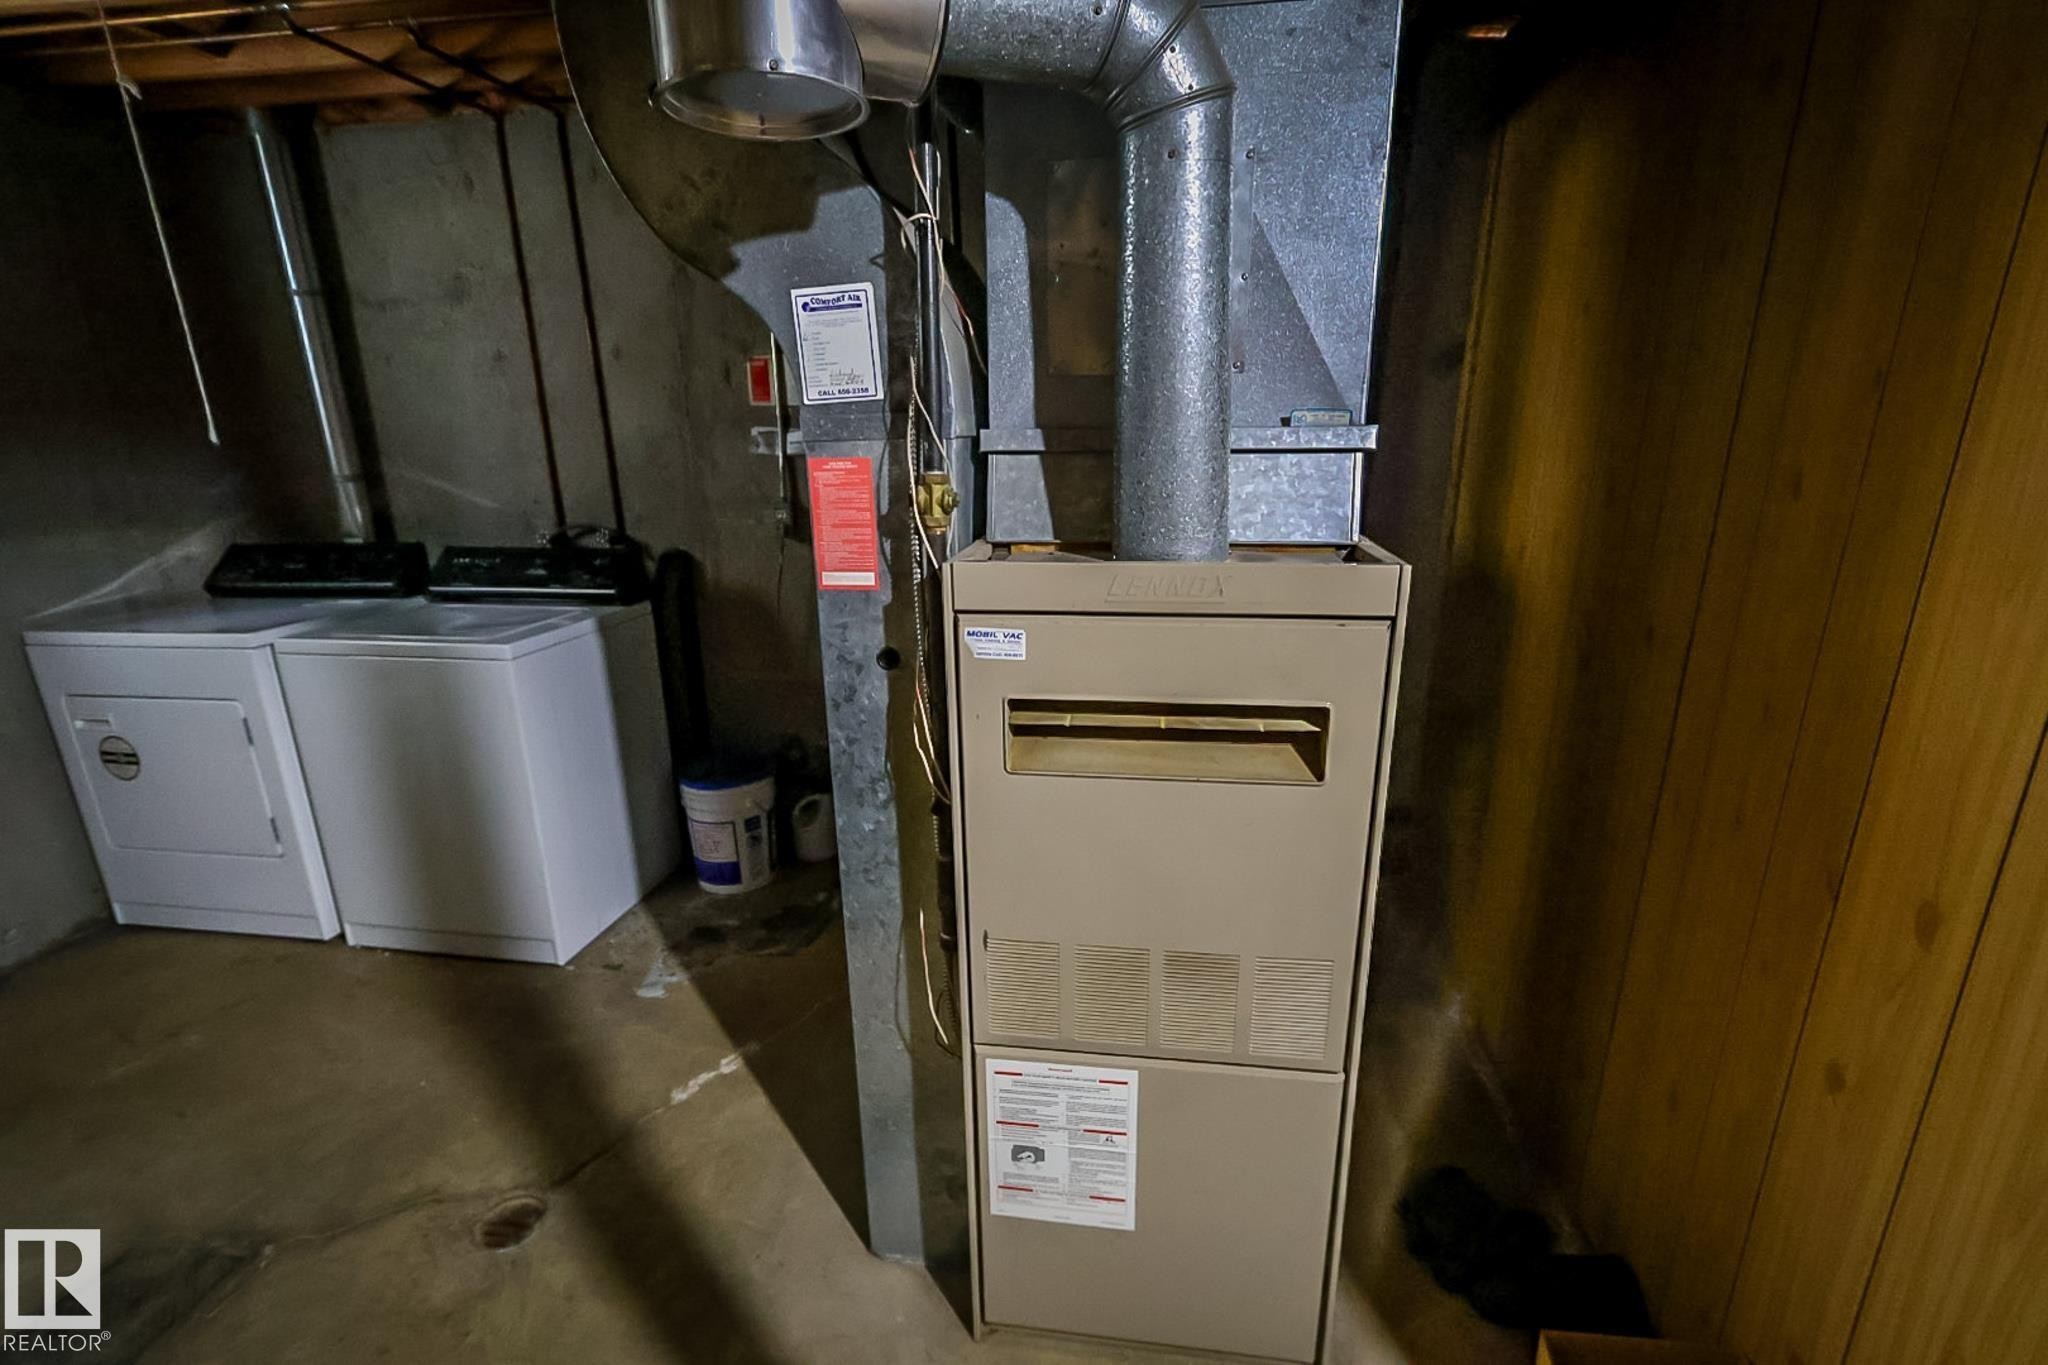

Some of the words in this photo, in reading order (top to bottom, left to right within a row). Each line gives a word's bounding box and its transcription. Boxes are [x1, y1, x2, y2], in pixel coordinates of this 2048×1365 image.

[810, 294, 846, 305] COMFORT
[847, 294, 862, 302] AIR
[1106, 574, 1232, 598] LENNOX
[966, 630, 999, 639] MOBIL
[1002, 632, 1024, 640] VAC
